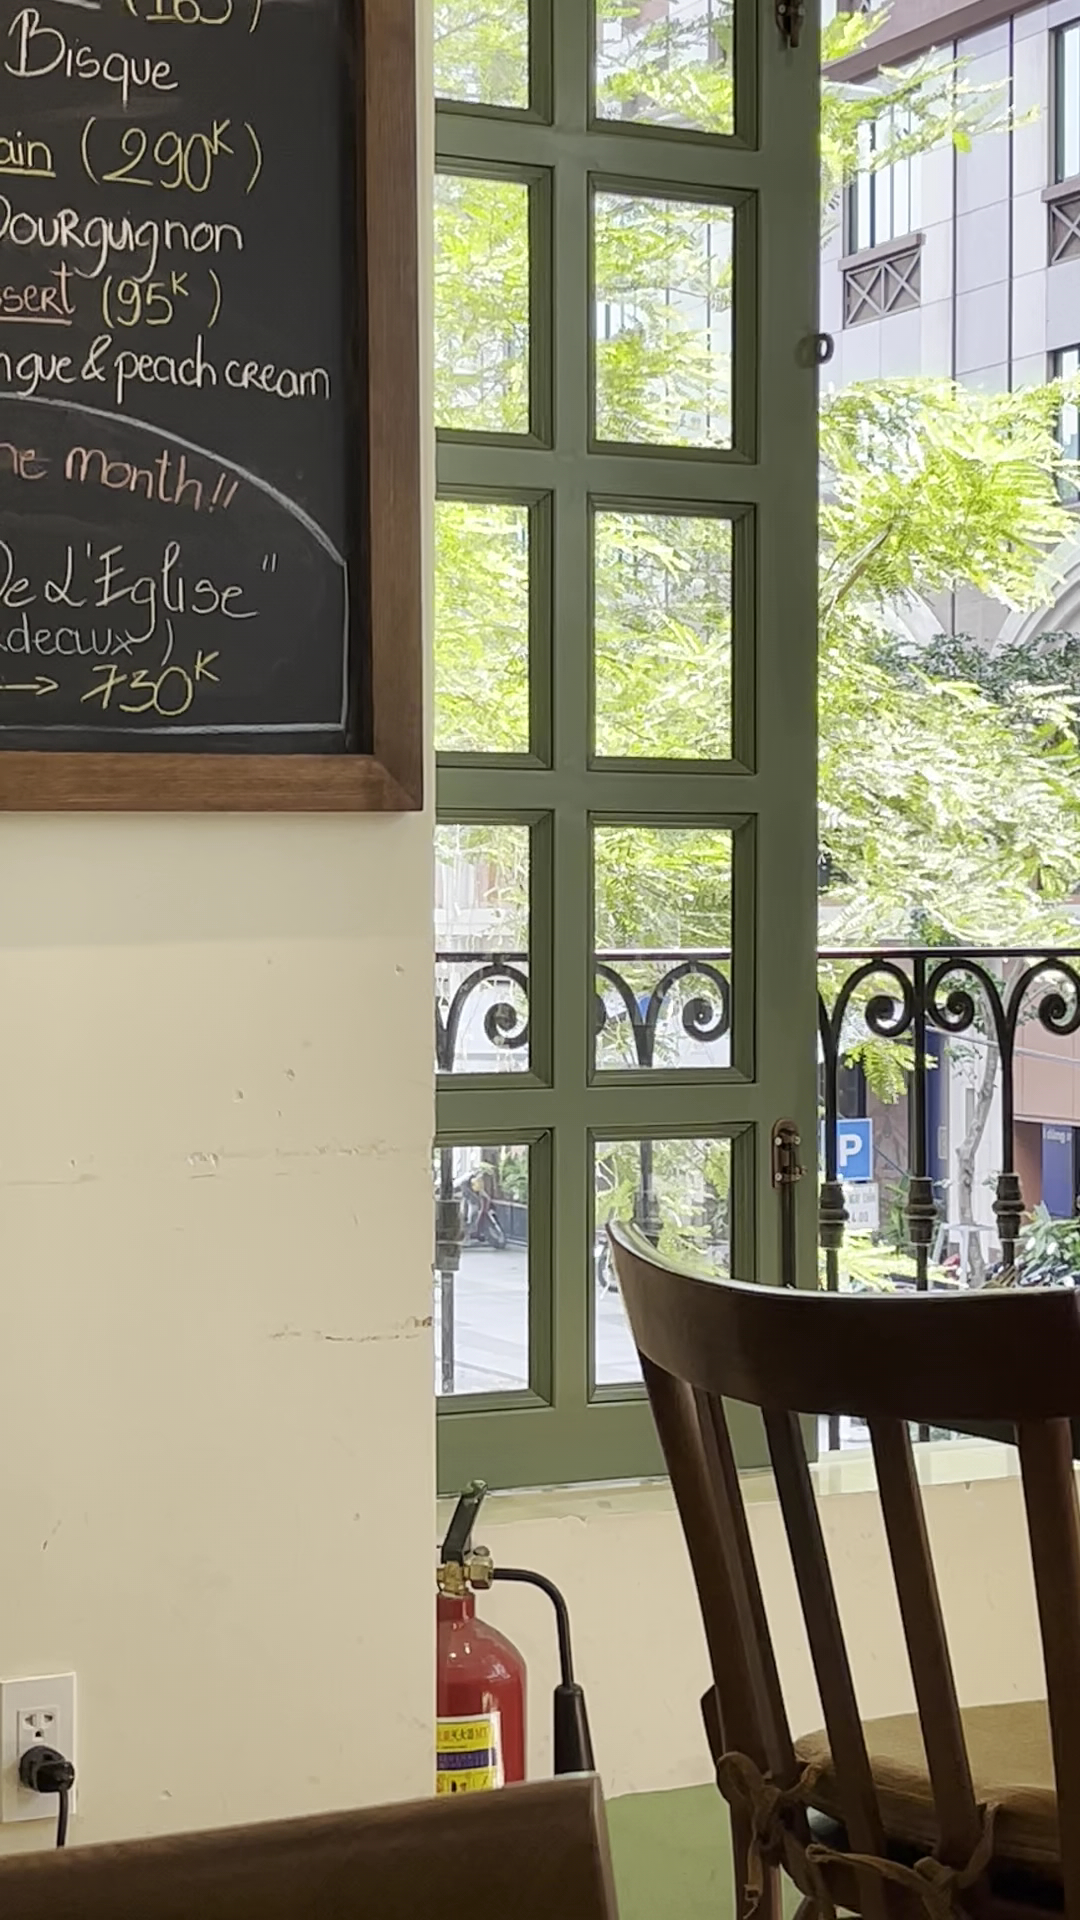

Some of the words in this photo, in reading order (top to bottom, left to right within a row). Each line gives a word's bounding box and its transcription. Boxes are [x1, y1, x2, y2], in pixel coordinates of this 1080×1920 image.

[4, 8, 179, 109] Bisque
[0, 260, 76, 315] sert
[81, 334, 107, 382] &
[114, 334, 216, 404] peach
[0, 611, 174, 666] deaux)
[839, 1134, 863, 1167] P
